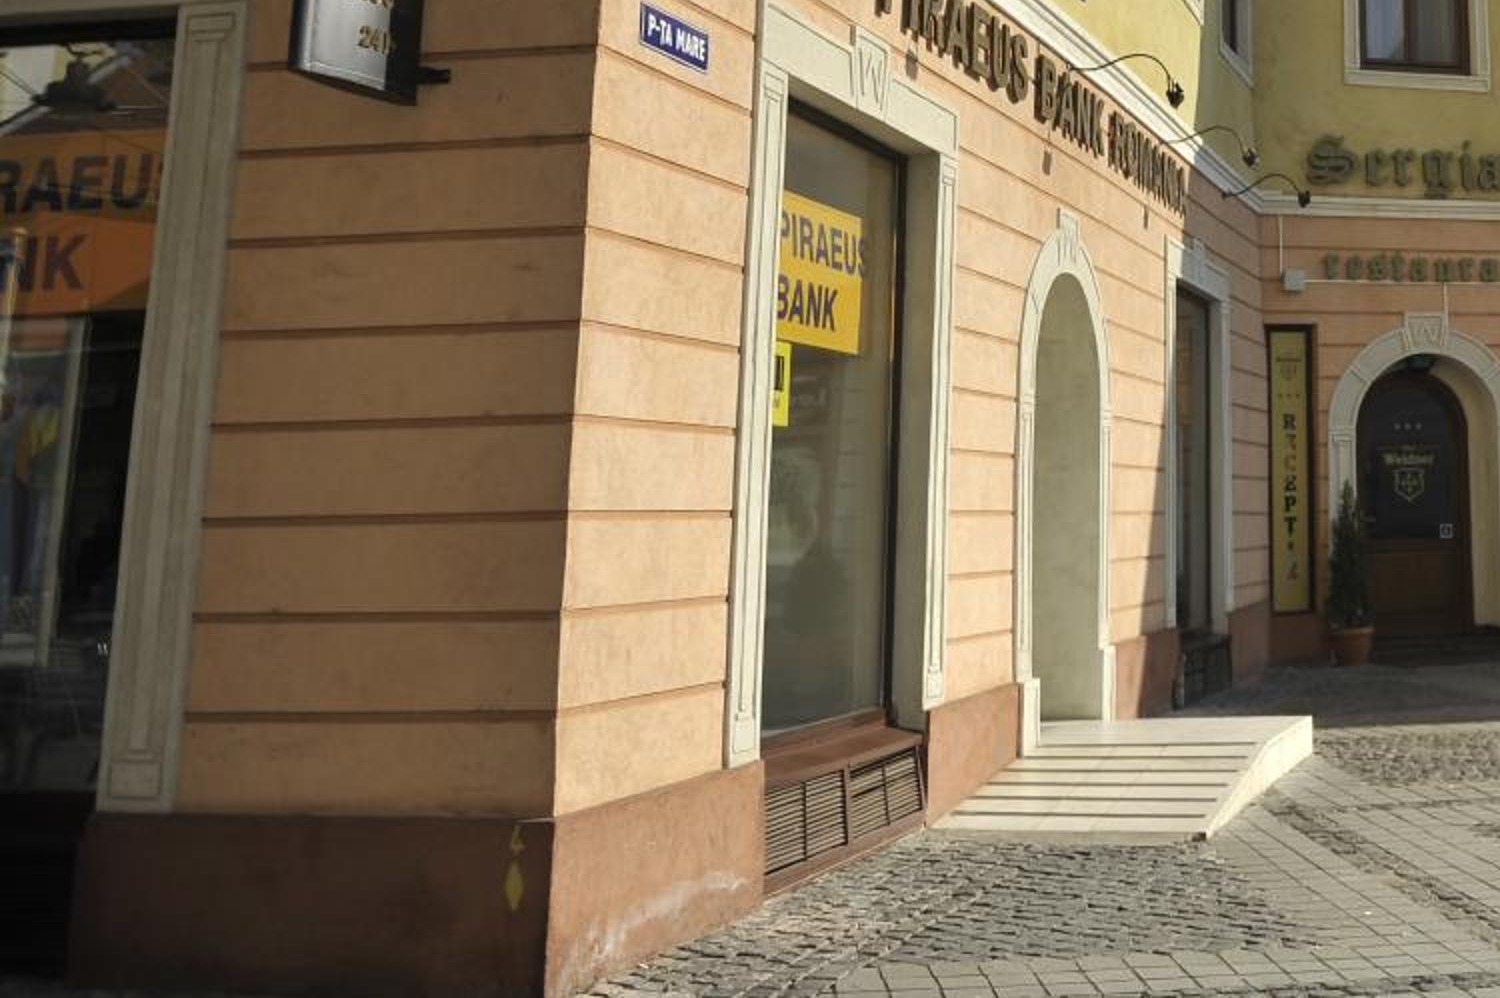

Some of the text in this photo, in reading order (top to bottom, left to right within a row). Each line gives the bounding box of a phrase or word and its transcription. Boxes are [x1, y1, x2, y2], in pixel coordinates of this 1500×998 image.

[675, 27, 706, 63] MARE
[1034, 54, 1105, 159] BANK
[776, 272, 838, 333] BANK
